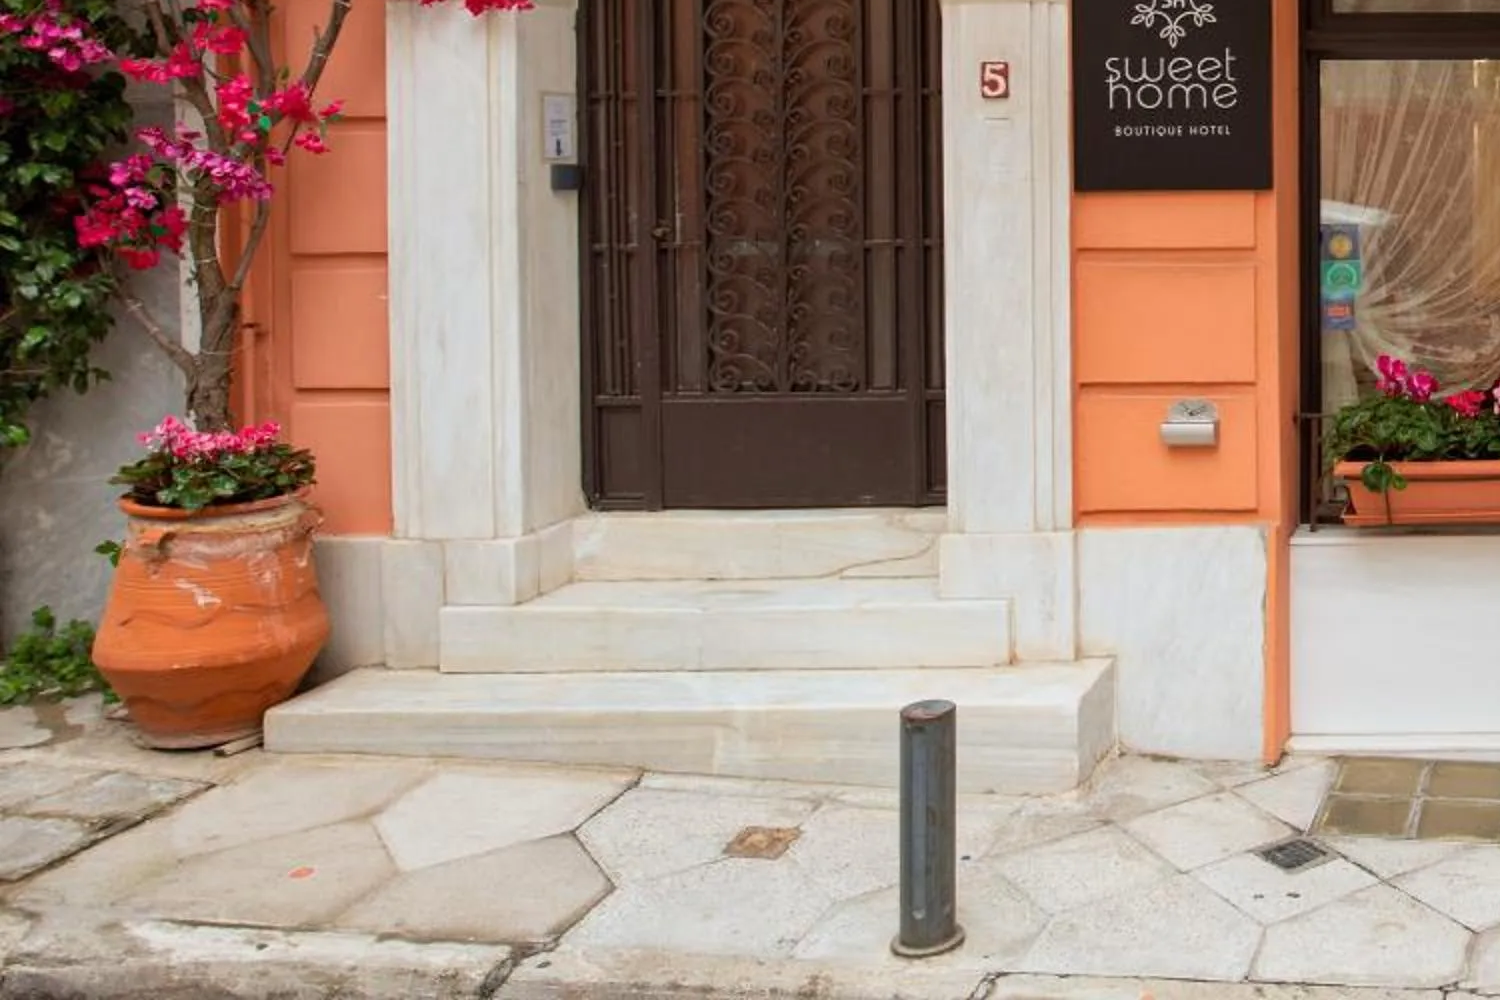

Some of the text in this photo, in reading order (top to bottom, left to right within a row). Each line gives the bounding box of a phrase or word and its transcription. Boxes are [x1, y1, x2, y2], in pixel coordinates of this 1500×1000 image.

[983, 63, 1006, 97] 5
[1105, 47, 1237, 82] sweet
[1109, 74, 1237, 109] home
[1115, 125, 1231, 137] BOUTIQUE HOTEL
